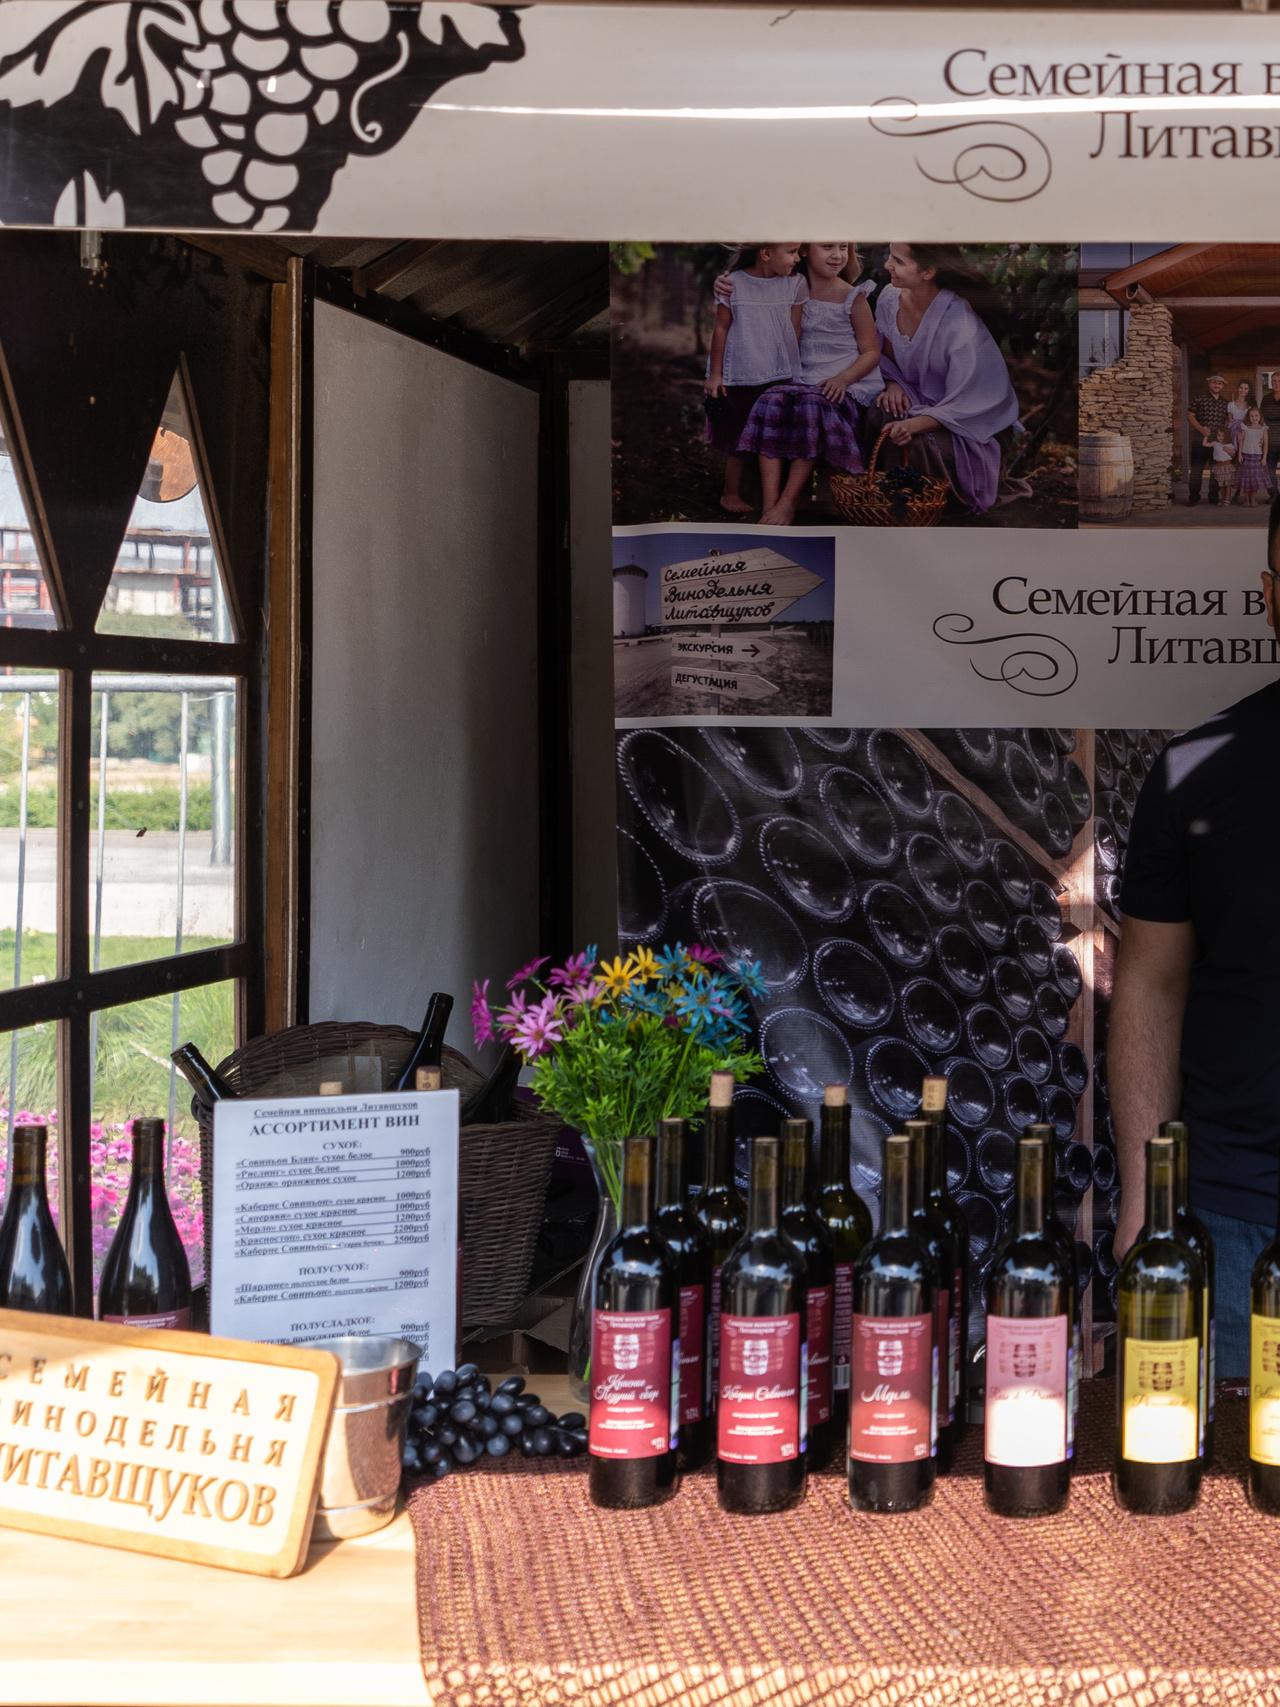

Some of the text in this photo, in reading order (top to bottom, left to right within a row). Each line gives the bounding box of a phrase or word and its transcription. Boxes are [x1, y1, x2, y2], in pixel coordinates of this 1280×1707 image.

[943, 48, 1243, 98] Семейная
[664, 560, 747, 582] Семейная
[664, 580, 775, 603] Винодельня
[992, 576, 1228, 616] Семейная
[665, 601, 775, 623] Литавщуков
[677, 642, 733, 655] ЭКСКУРСИЯ
[675, 672, 738, 690] ДЕГУСТАЦИЯ
[254, 1102, 418, 1118] Семейная винодельня Литавщуков
[249, 1114, 420, 1136] АССОРТИМЕНТ ВИН
[322, 1141, 363, 1150] СУХОЕ:
[299, 1262, 369, 1276] ПОЛУСУХОЕ:
[291, 1316, 376, 1332] ПОЛУСЛАДКОЕ:
[0, 1398, 287, 1467] ИНОДЕЛЬНЯ
